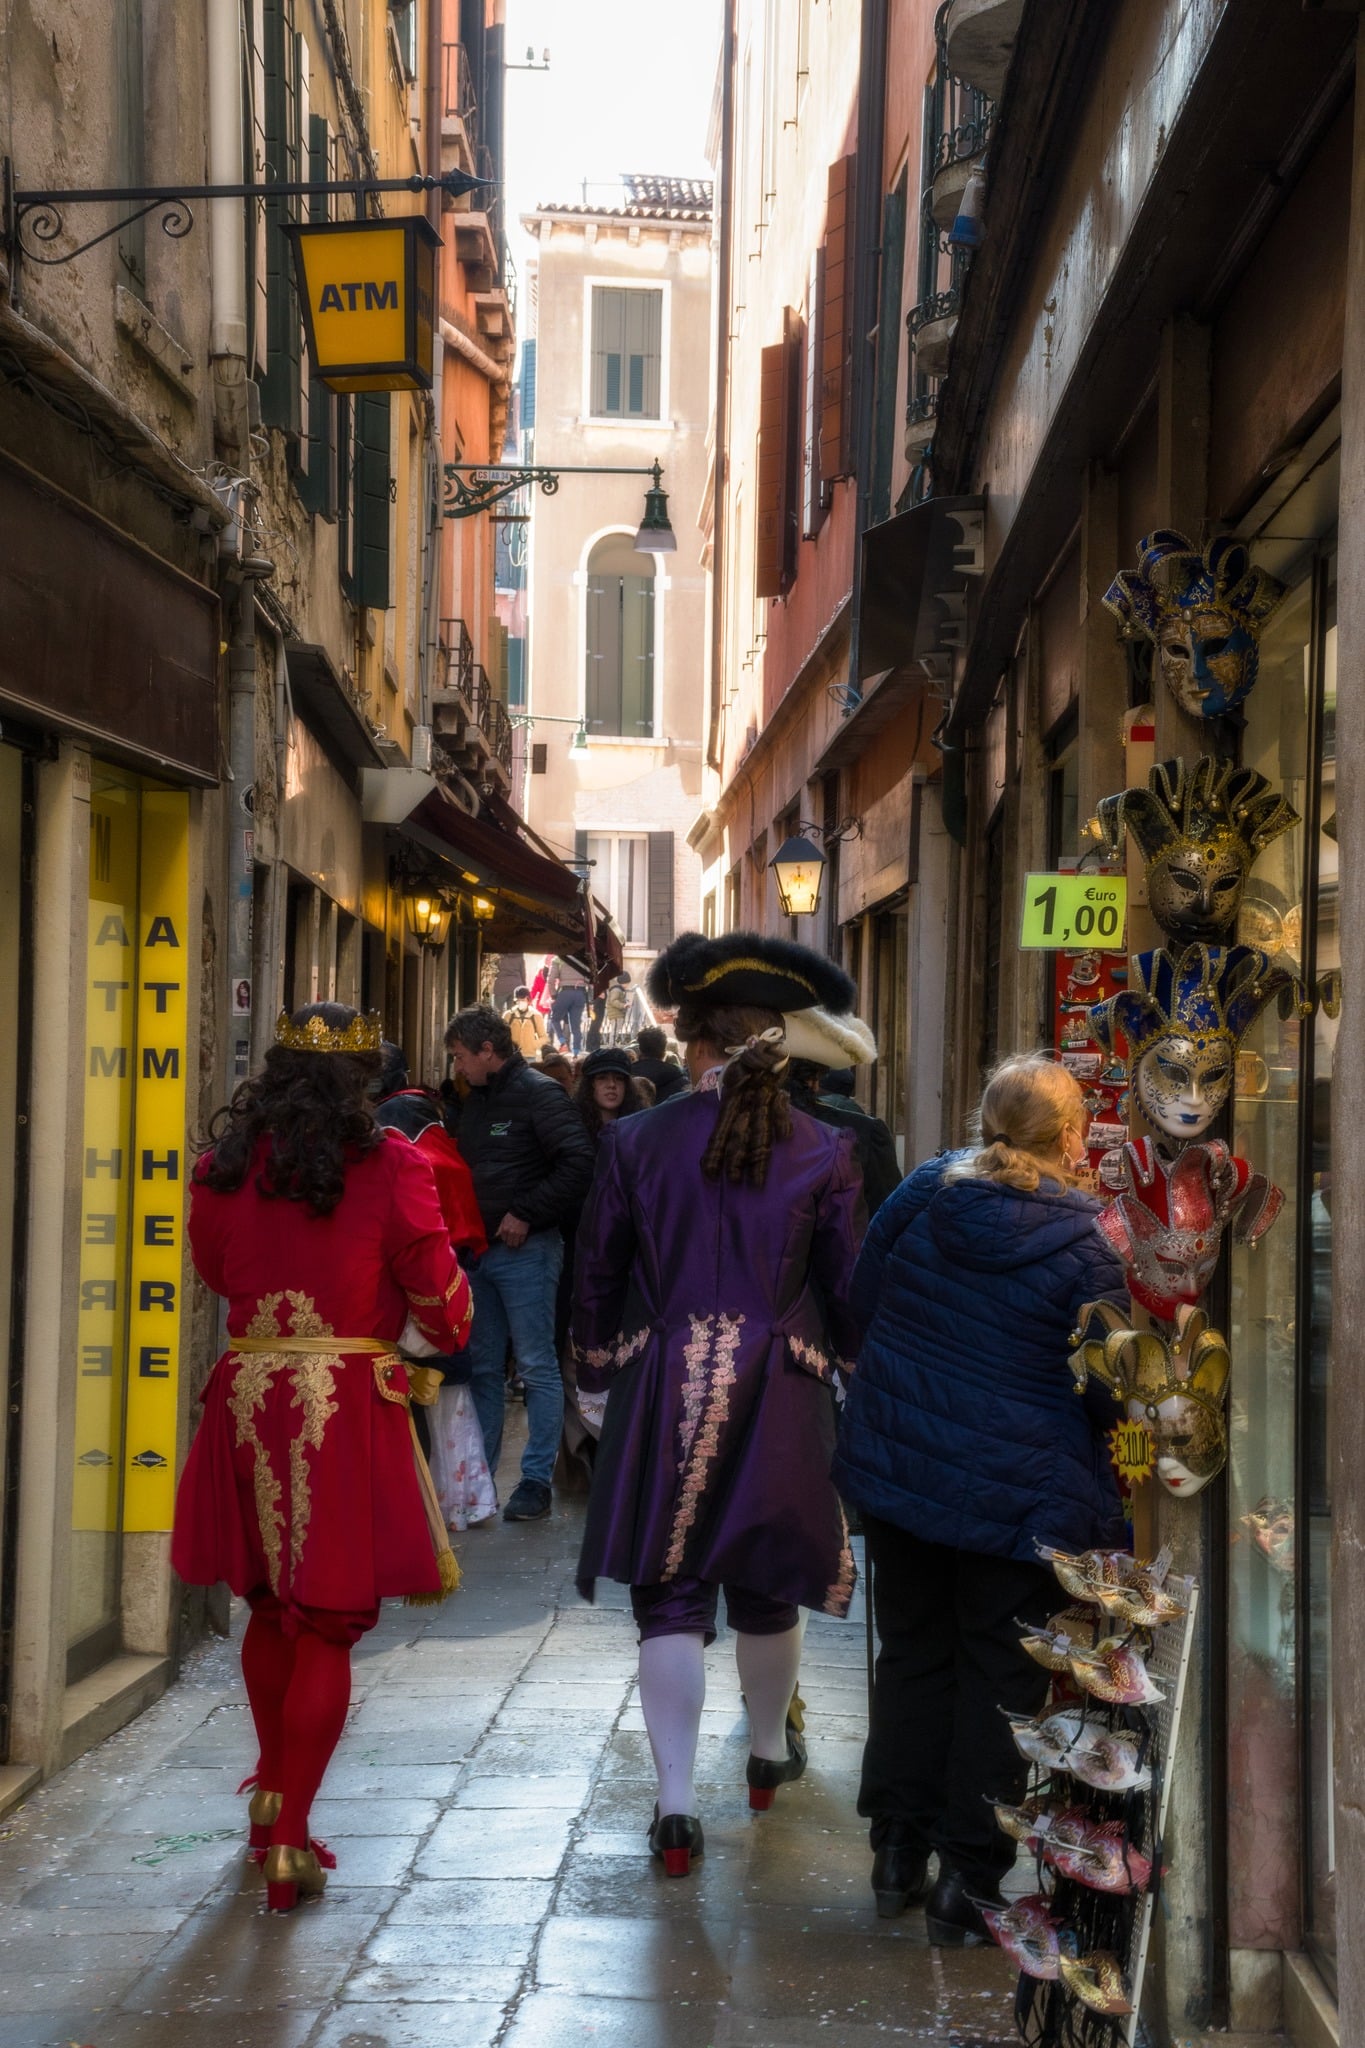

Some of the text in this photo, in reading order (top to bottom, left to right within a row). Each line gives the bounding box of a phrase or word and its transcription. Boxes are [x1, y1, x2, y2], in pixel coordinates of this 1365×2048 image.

[319, 281, 398, 312] ATM
[1033, 886, 1118, 941] 1,00
[139, 917, 180, 1378] ATM HERE
